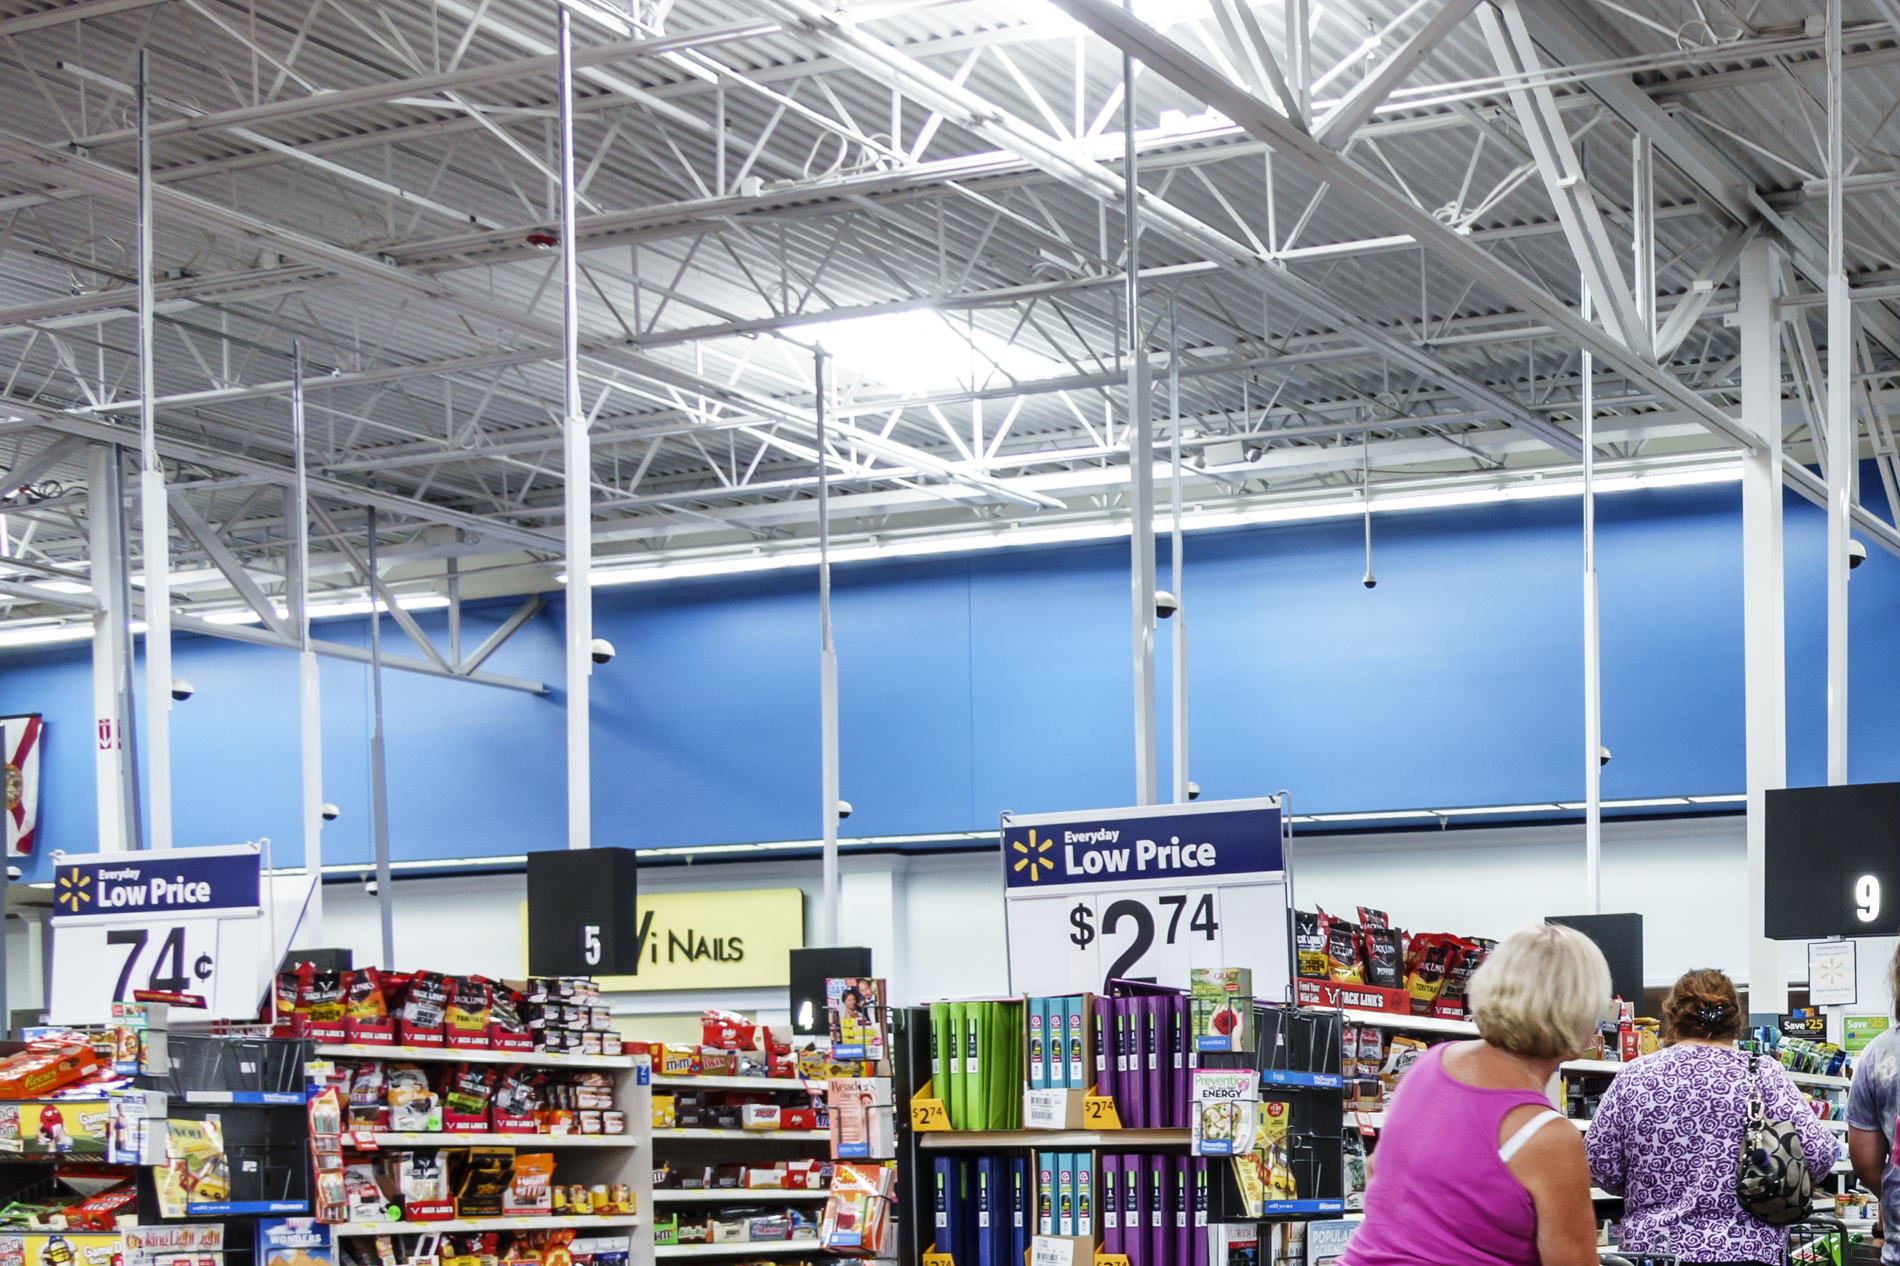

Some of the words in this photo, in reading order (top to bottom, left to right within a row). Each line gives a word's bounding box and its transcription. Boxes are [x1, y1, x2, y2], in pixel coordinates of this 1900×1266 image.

[1064, 828, 1120, 844] Everyday
[1065, 844, 1130, 875] Low
[1136, 836, 1216, 871] Price
[98, 868, 141, 881] Everyday
[98, 882, 147, 907] Low
[151, 876, 211, 904] Price
[1855, 874, 1880, 922] 9
[585, 925, 601, 966] 5
[669, 929, 744, 963] NAILS
[1299, 981, 1309, 991] Feed
[1309, 983, 1320, 992] Your
[1299, 991, 1310, 1002] Wild
[1360, 991, 1384, 1008] LINK'S
[799, 1000, 814, 1030] 4
[1784, 1020, 1805, 1030] Save
[1806, 1019, 1823, 1030] $25
[1847, 1020, 1867, 1029] Save
[1868, 1018, 1884, 1028] $25
[831, 1081, 876, 1092] Reader's
[1195, 1074, 1250, 1086] Prevention
[1202, 1090, 1242, 1099] ENERGY
[126, 1231, 169, 1250] Cooking
[170, 1230, 195, 1248] Light
[269, 1233, 322, 1244] WONDERS
[84, 1246, 113, 1257] Game
